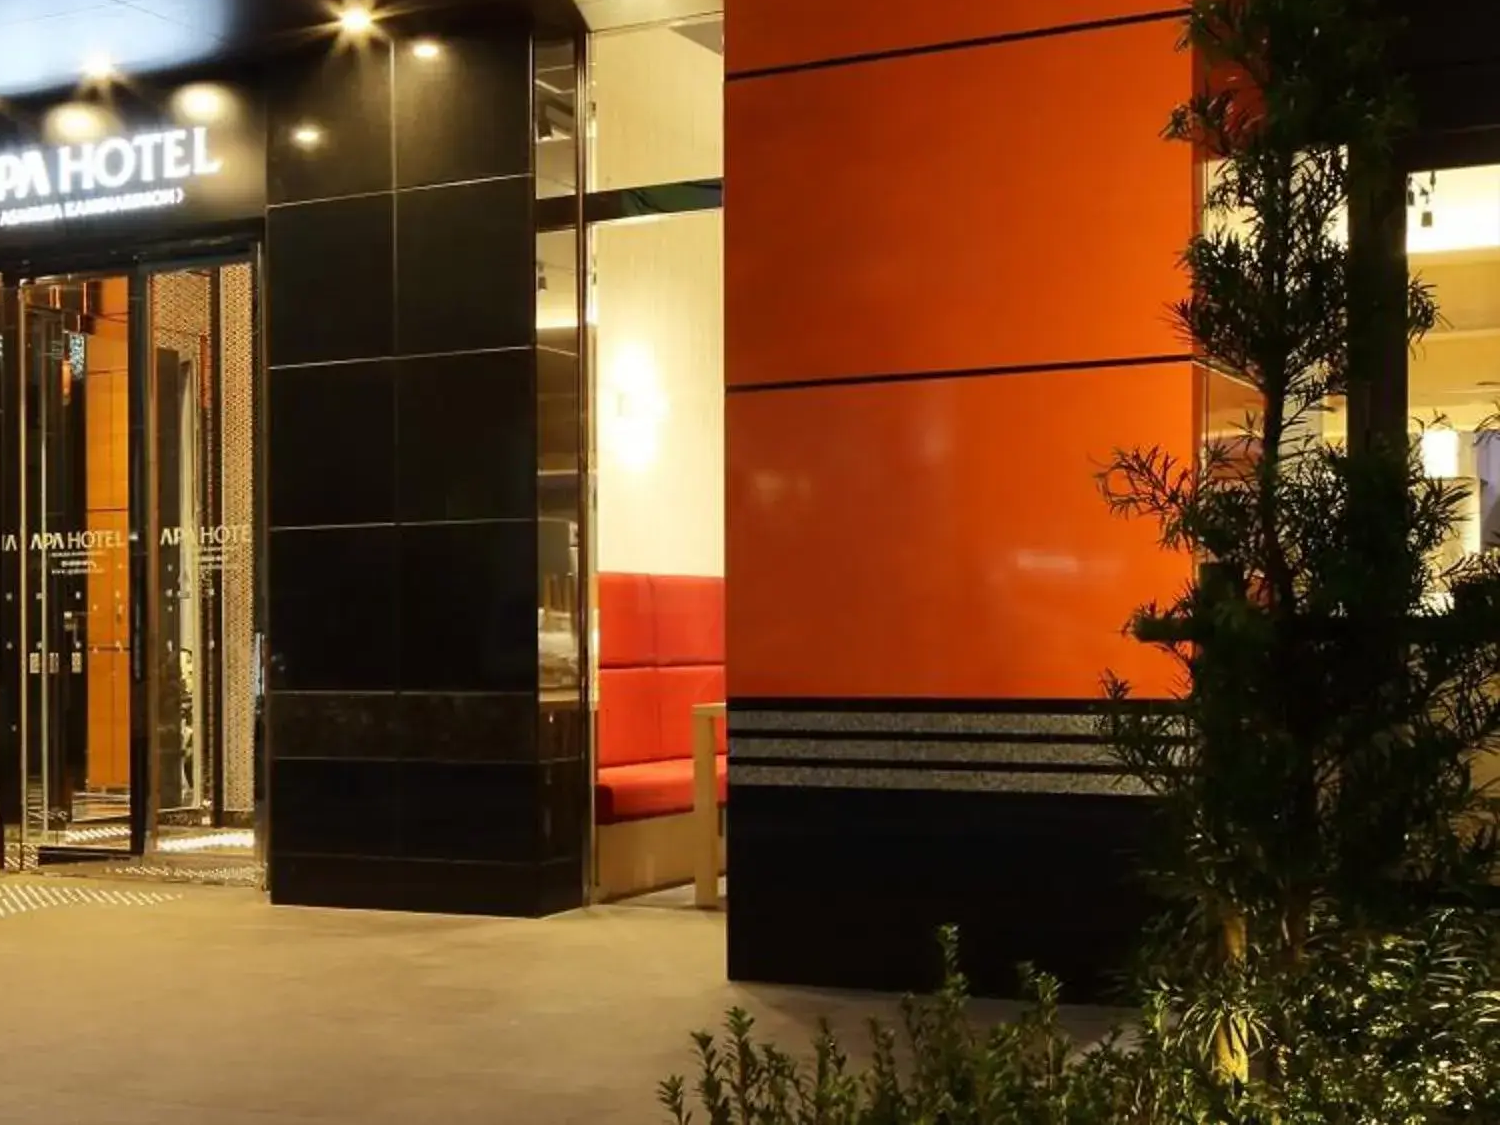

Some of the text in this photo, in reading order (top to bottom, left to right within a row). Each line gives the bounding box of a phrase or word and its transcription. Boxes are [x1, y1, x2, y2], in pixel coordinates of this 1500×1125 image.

[56, 127, 224, 193] HOTEL
[30, 530, 125, 551] APA HOTEL
